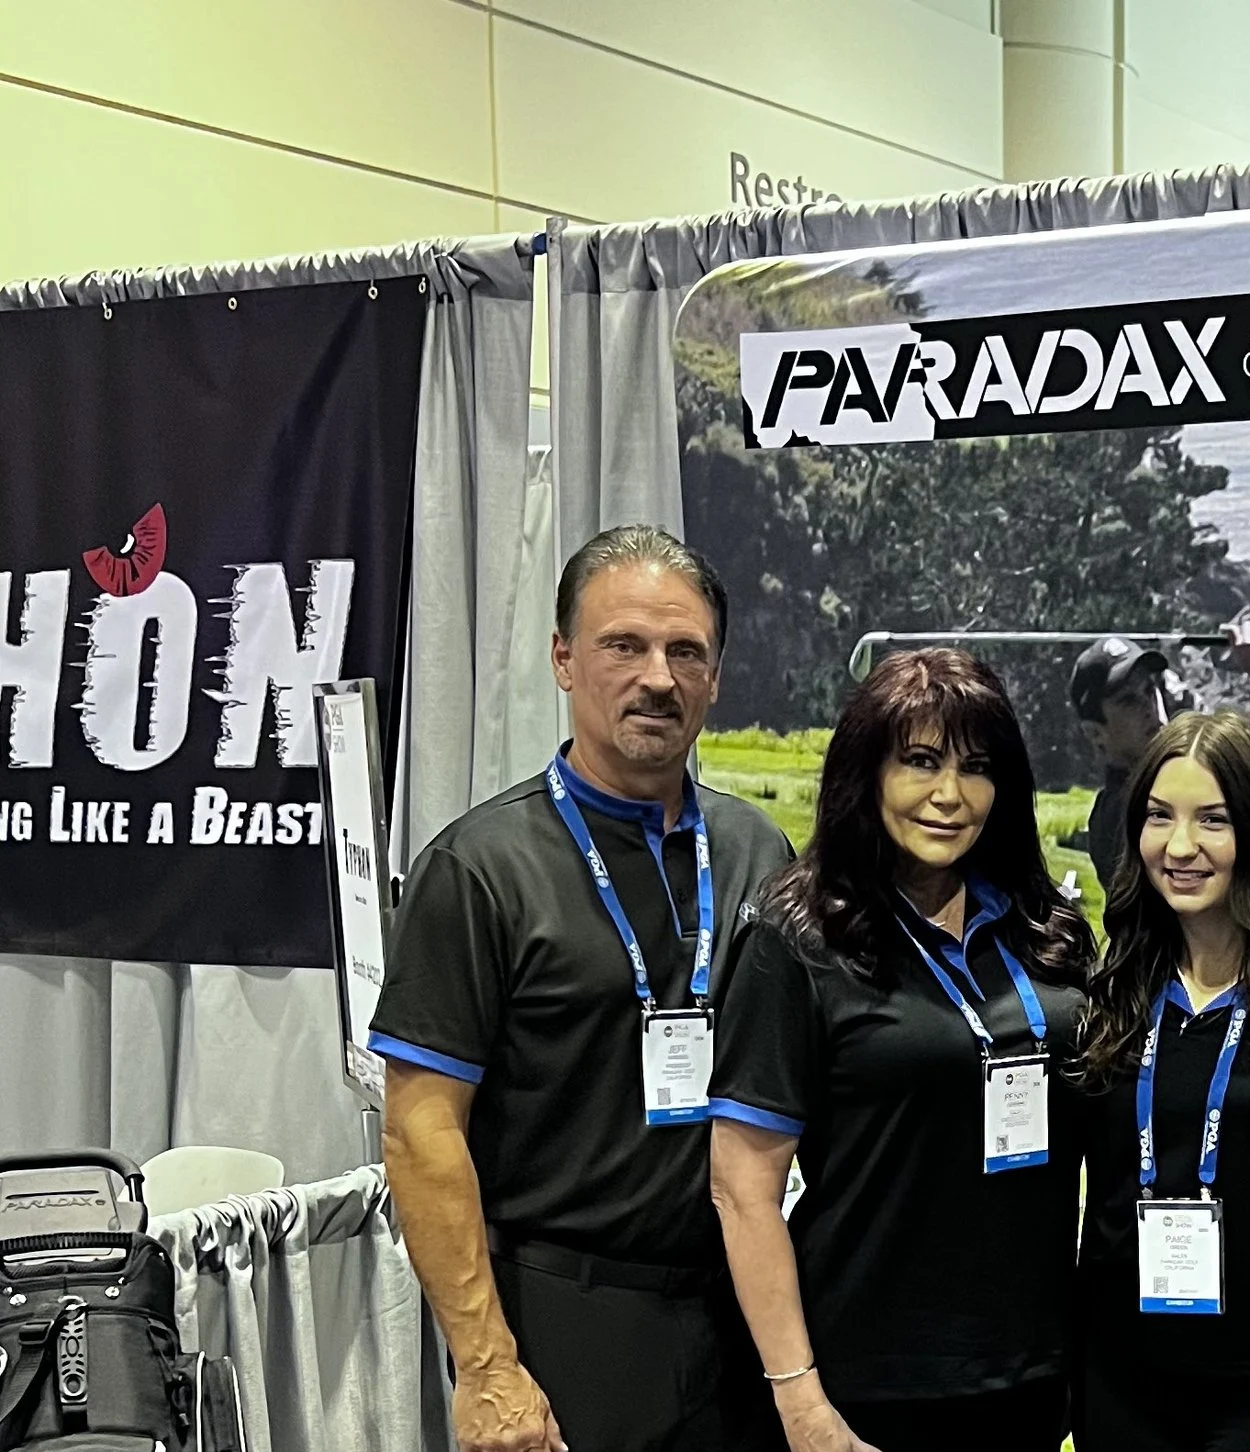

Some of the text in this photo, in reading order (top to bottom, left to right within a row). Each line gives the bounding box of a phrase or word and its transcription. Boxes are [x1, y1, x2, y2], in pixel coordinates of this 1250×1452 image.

[760, 317, 1227, 428] PARADAX
[697, 939, 709, 967] PGA
[1144, 1026, 1156, 1055] PGA
[1227, 1019, 1244, 1048] PGA
[1140, 1127, 1150, 1158] PGA
[1205, 1121, 1220, 1154] PGA
